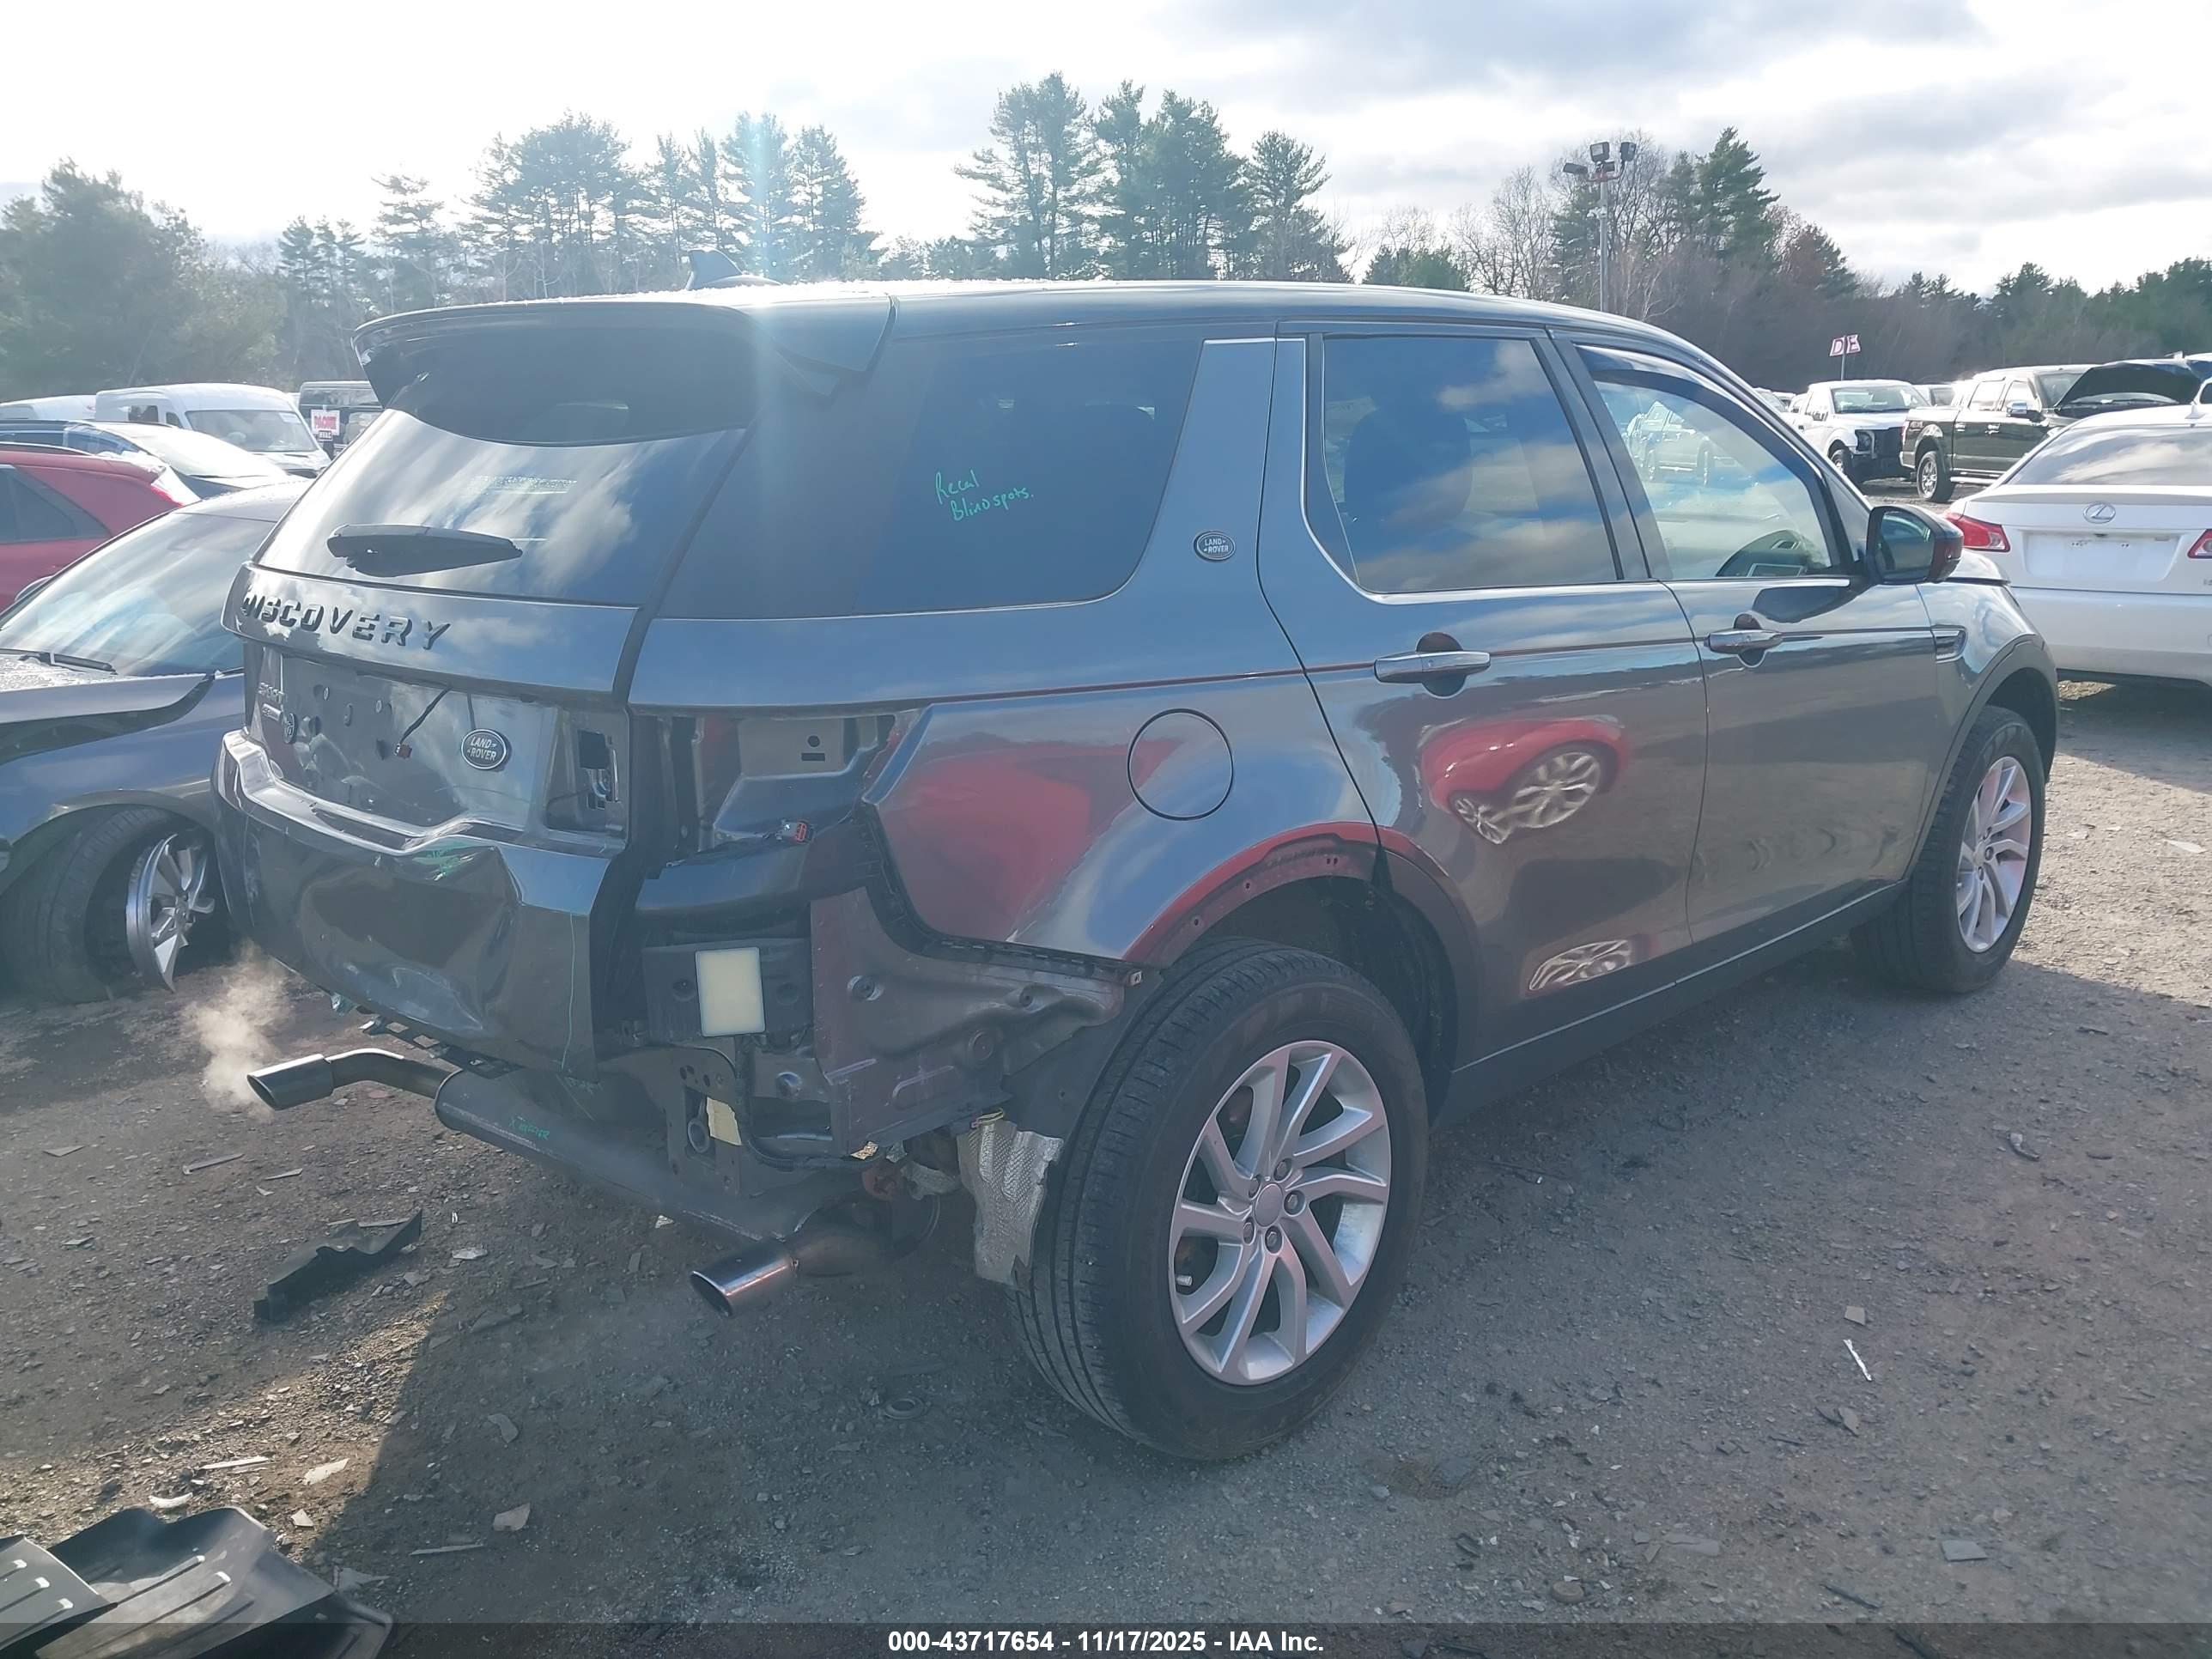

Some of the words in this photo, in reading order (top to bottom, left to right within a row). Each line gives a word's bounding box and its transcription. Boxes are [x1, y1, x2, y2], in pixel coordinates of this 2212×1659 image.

[1204, 538, 1223, 546] LAND
[1207, 545, 1229, 554] ROVER
[241, 594, 452, 651] DISCOVERY
[471, 737, 492, 749] LAND
[470, 747, 497, 761] ROVER
